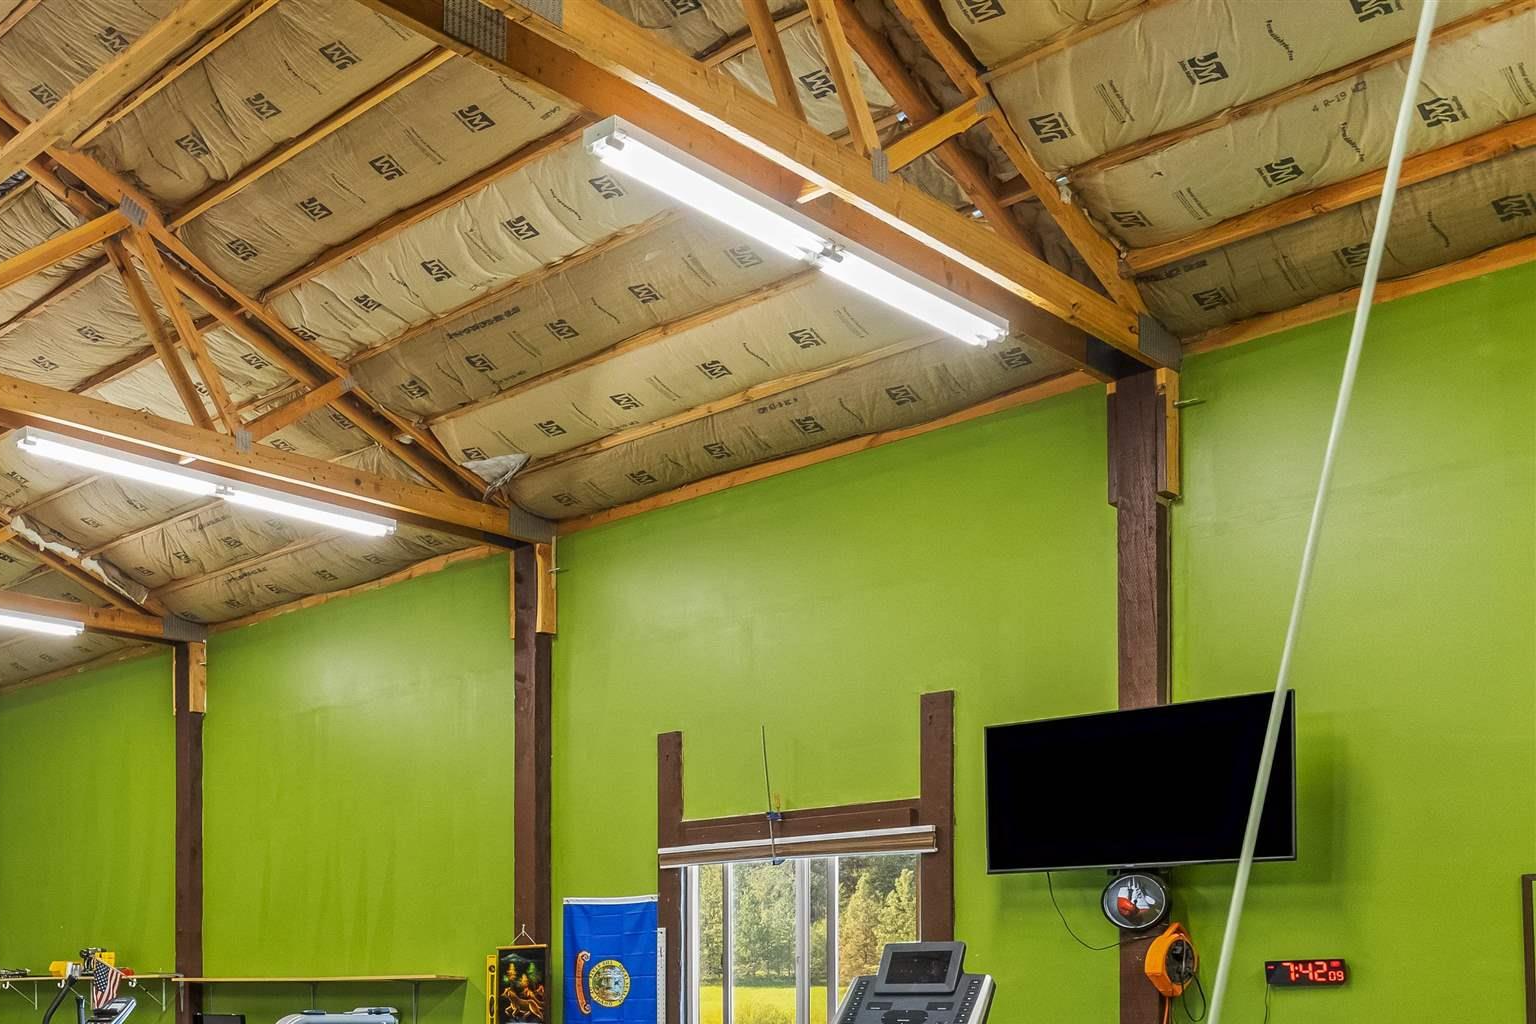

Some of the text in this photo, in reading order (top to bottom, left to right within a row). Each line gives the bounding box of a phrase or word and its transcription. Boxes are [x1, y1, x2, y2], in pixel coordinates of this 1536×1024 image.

[318, 40, 358, 70] JM
[1188, 52, 1228, 85] JM
[799, 70, 837, 99] JM
[246, 93, 282, 121] JM
[457, 104, 496, 131] JM
[1417, 97, 1460, 127] JM
[1028, 113, 1068, 144] JM
[175, 134, 210, 159] JM
[369, 154, 405, 181] JM
[1264, 157, 1305, 186] JM
[588, 174, 624, 200] JM
[298, 197, 333, 221] JM
[1492, 194, 1533, 222] JM
[505, 215, 540, 240] JM
[226, 239, 259, 261] JM
[421, 259, 453, 282] JM
[354, 294, 382, 312] JM
[628, 284, 661, 304] JM
[548, 319, 579, 340] JM
[789, 329, 821, 349] JM
[466, 353, 495, 373] JM
[701, 360, 732, 379] JM
[999, 347, 1032, 369] JM
[609, 393, 640, 410] JM
[885, 385, 918, 406] JM
[537, 420, 566, 437] JM
[795, 416, 824, 434] JM
[1282, 961, 1344, 981] 7:42 09
